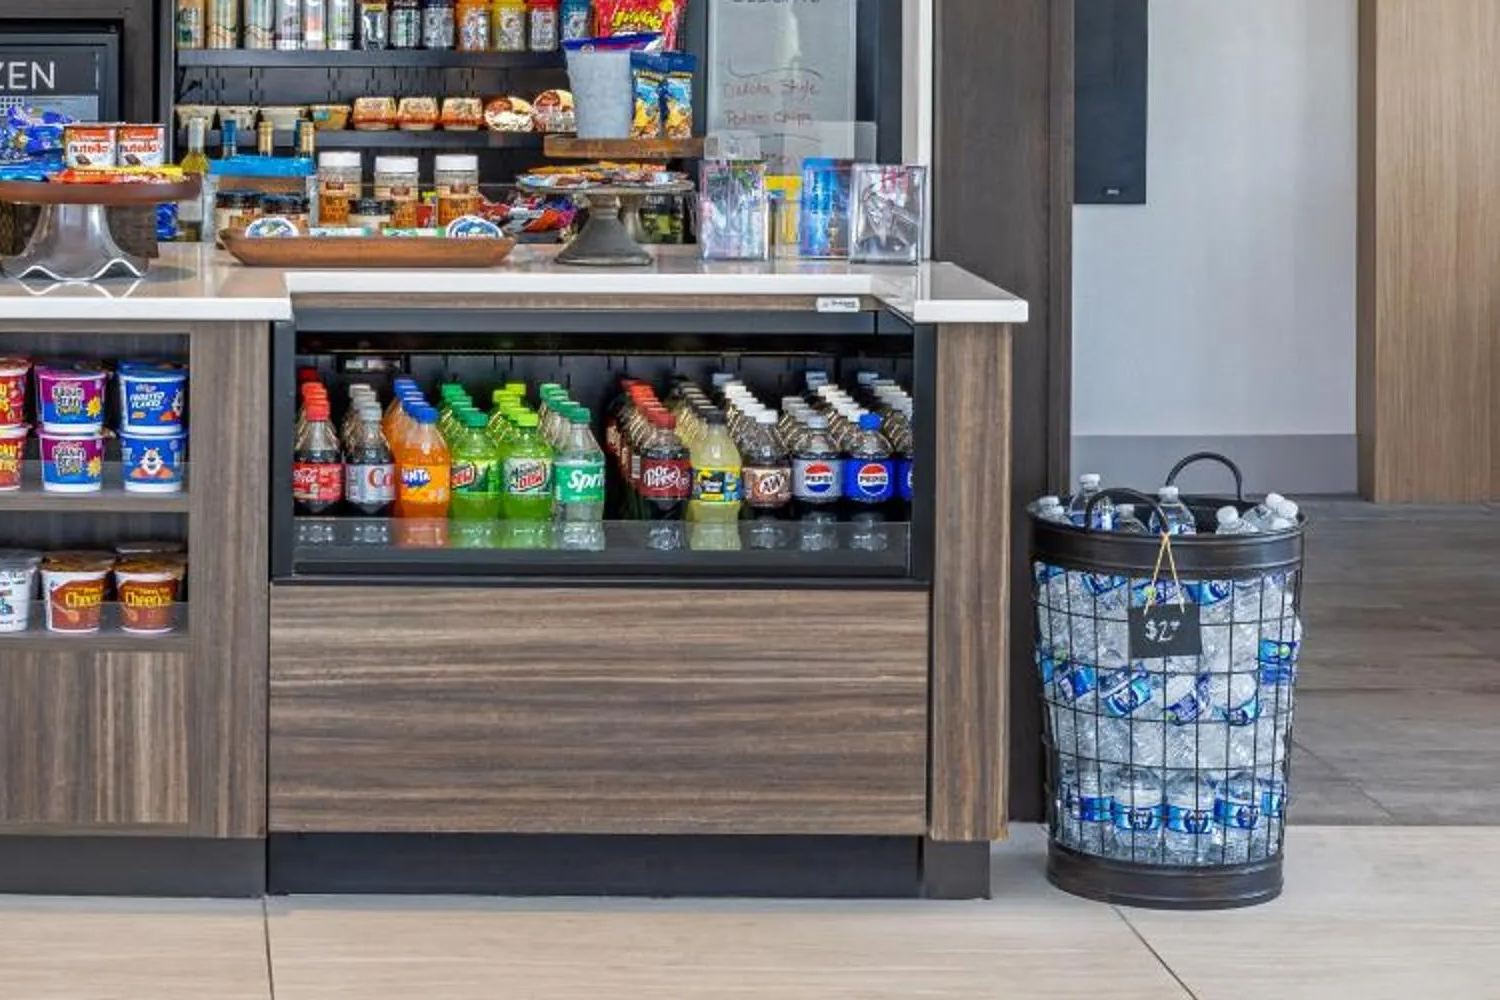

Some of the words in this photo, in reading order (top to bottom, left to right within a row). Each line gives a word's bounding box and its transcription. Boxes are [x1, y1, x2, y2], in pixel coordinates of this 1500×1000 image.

[70, 142, 109, 153] nutella
[120, 141, 157, 152] nutella
[805, 475, 833, 483] PEPSI
[859, 475, 887, 483] PEPSI
